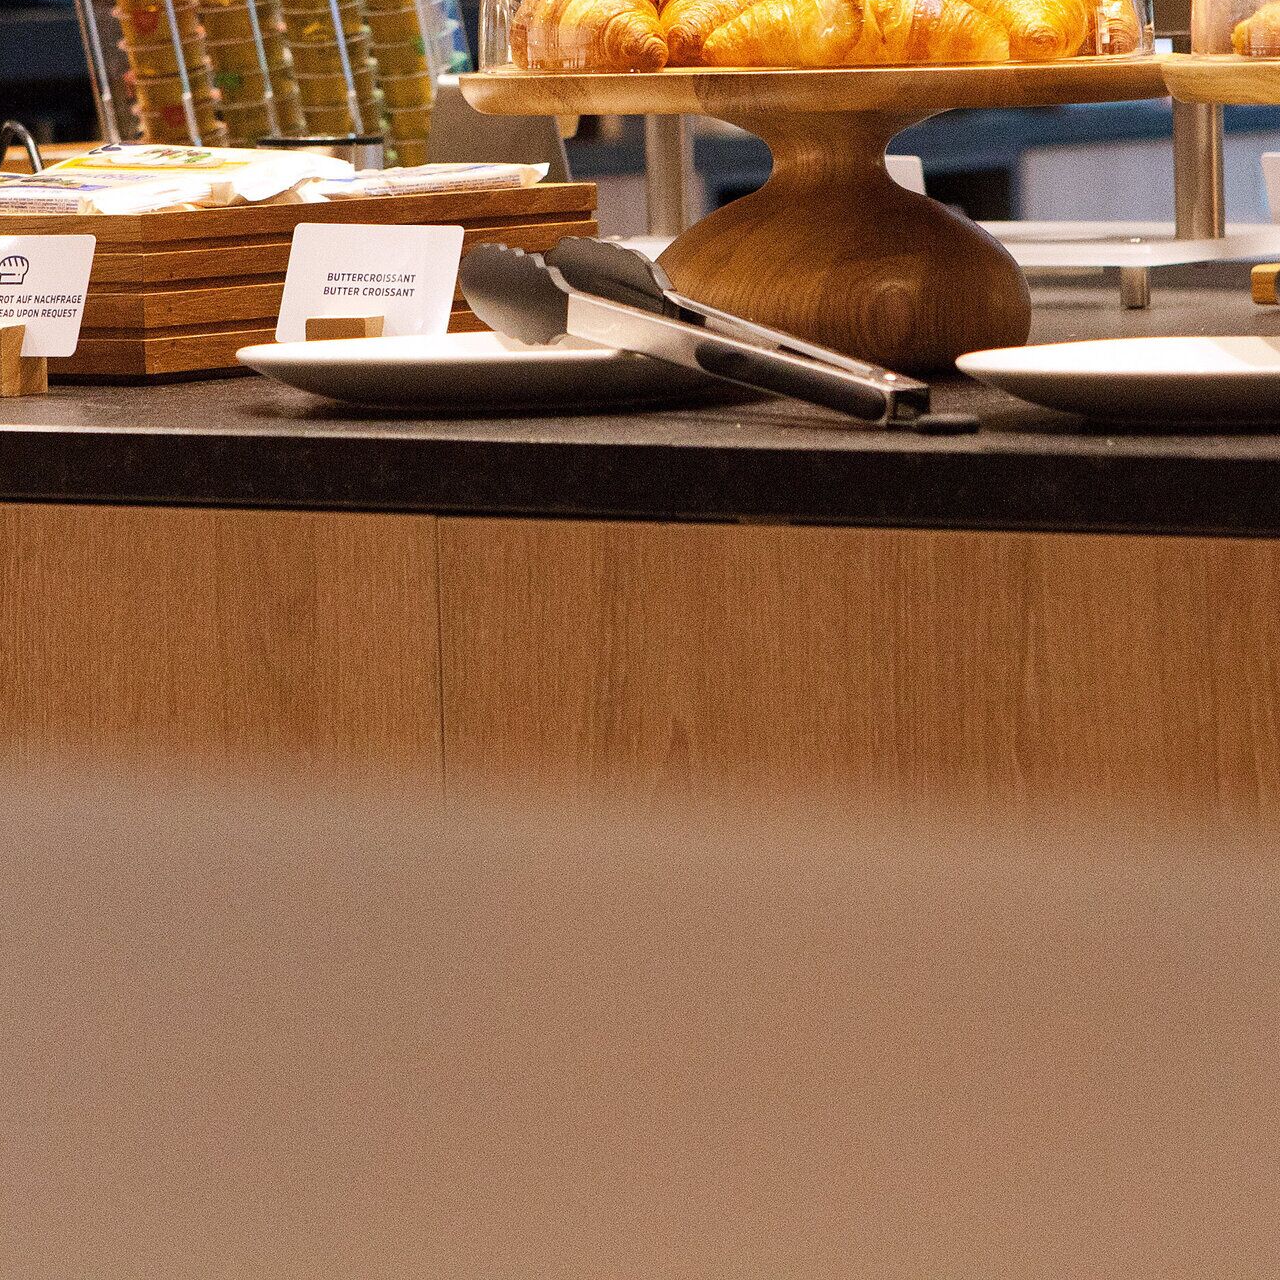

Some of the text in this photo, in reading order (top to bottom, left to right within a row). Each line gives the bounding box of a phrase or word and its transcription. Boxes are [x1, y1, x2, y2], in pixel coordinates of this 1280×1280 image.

[327, 272, 416, 283] BUTTERCROISSANT
[323, 286, 415, 297] BUTTER CROISSANT
[15, 294, 32, 304] AUF
[33, 294, 82, 304] NACHFRAGE
[16, 308, 39, 318] UPON
[40, 308, 77, 319] REQUEST
